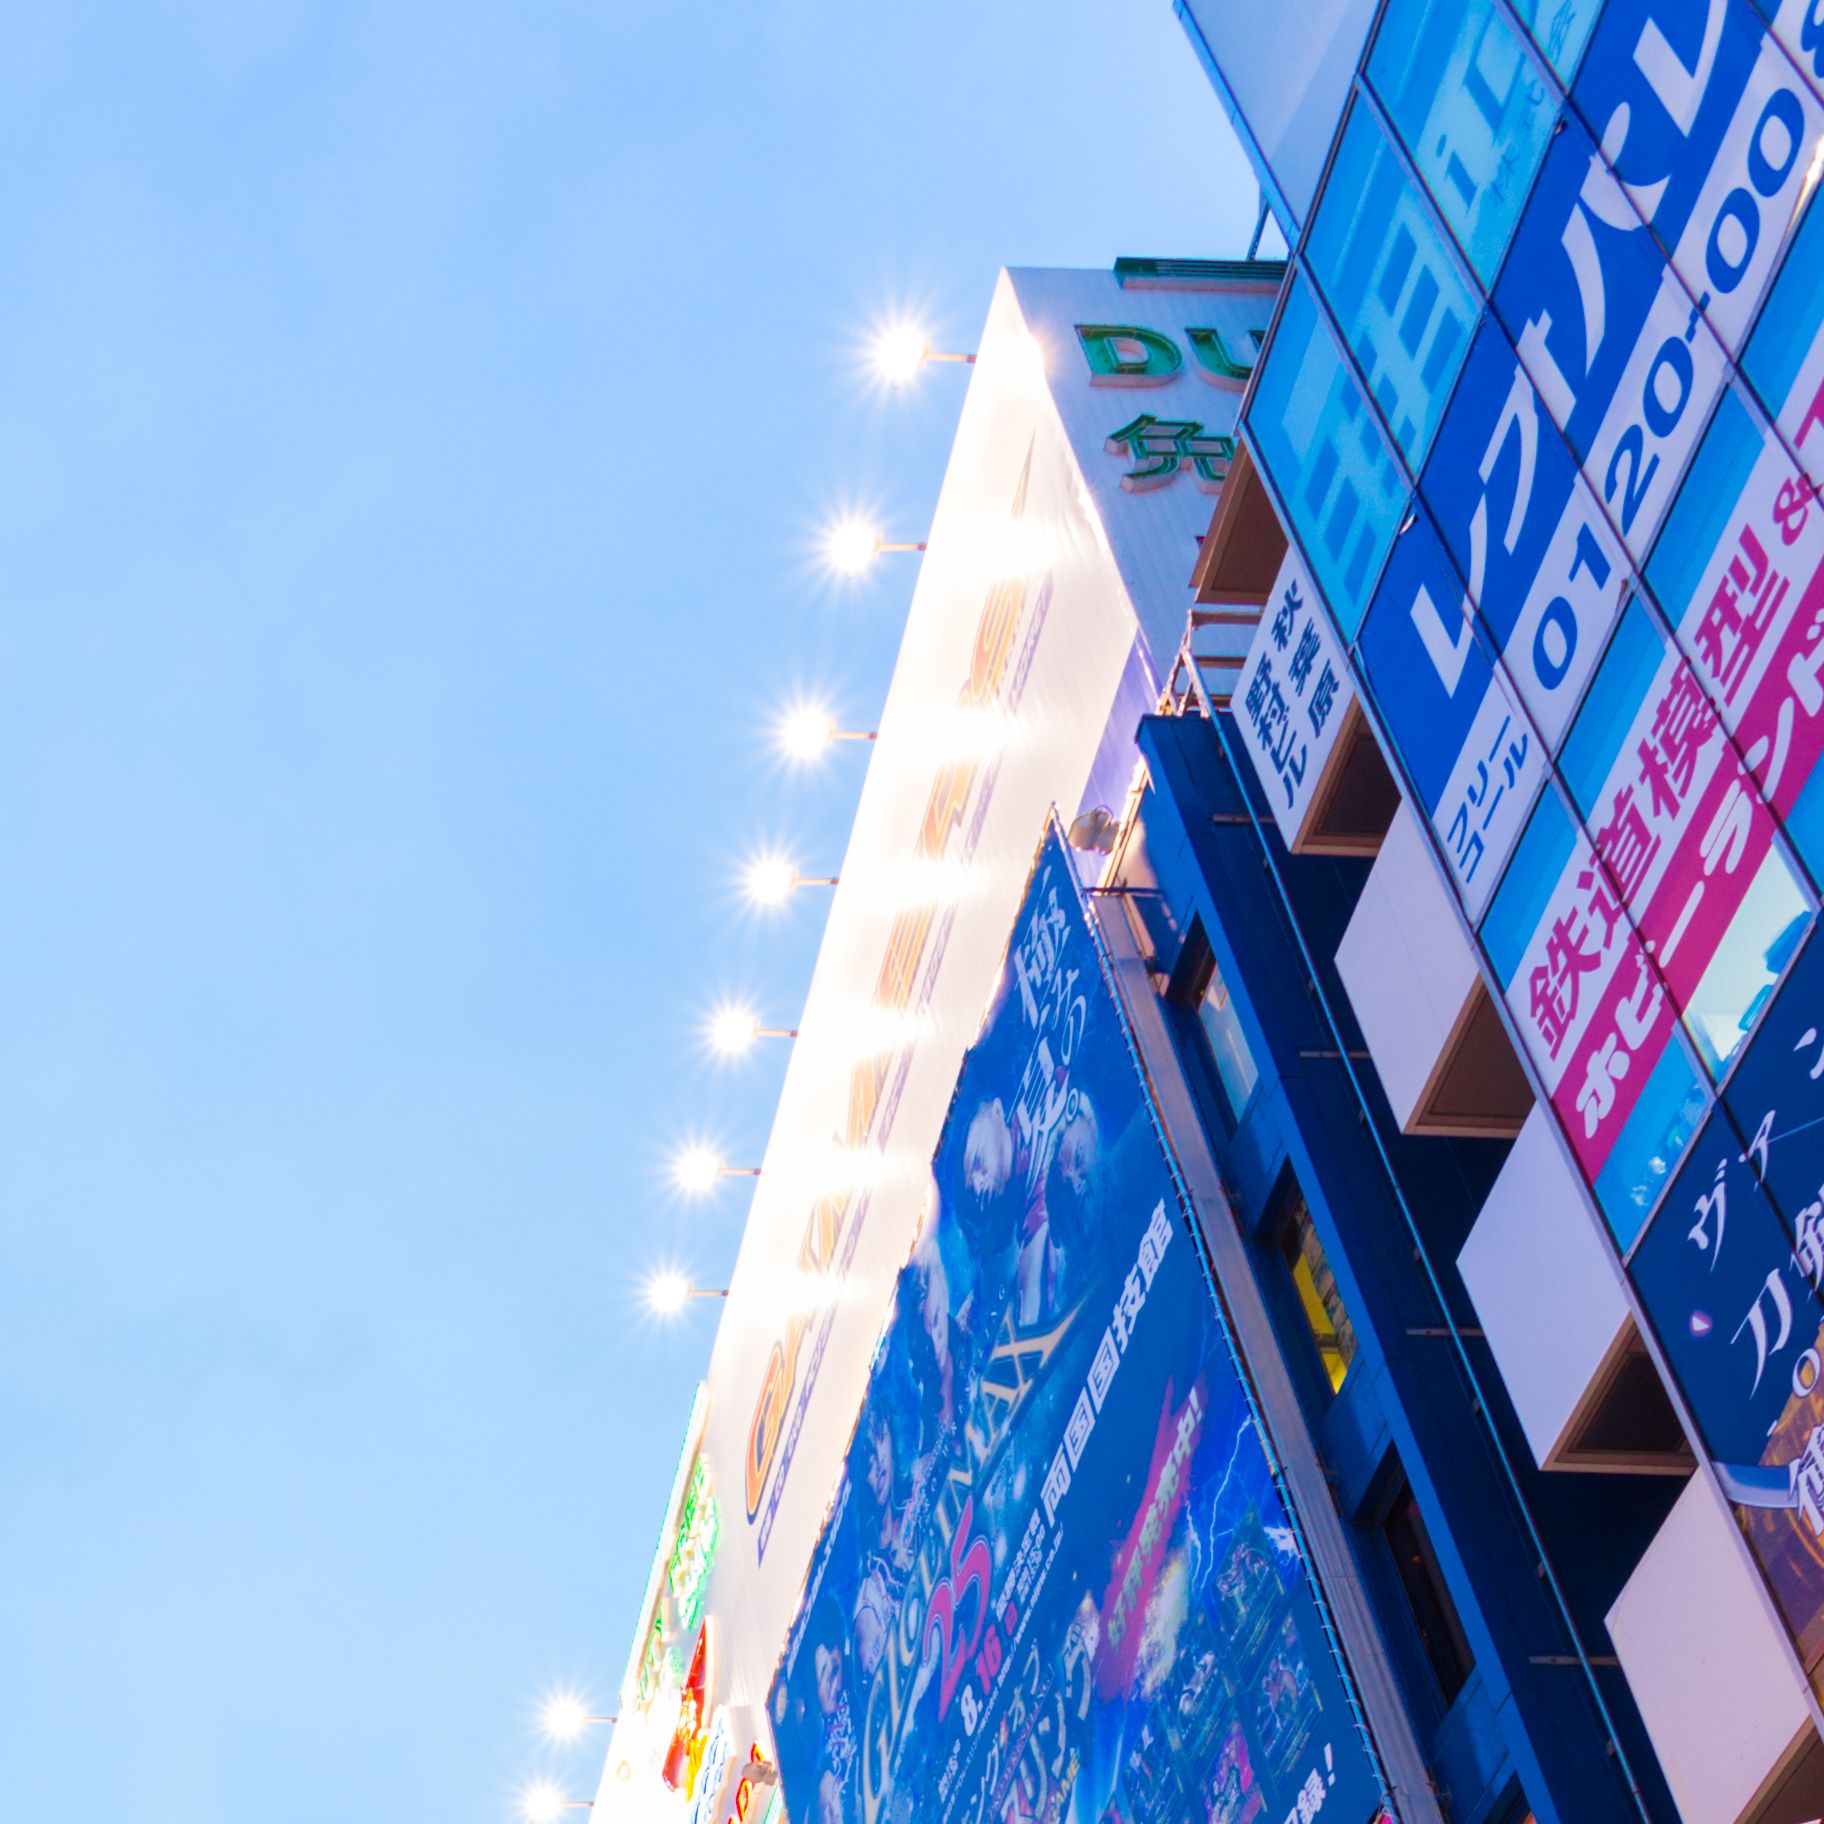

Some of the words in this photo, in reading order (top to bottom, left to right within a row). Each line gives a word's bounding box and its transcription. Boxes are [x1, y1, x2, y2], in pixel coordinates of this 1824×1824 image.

[1244, 650, 1308, 809] 野村ビル
[1270, 580, 1341, 738] 秋葉原
[1446, 714, 1511, 848] フリー
[1466, 734, 1528, 884] コール
[1530, 520, 1791, 1060] 鉄道模型
[1039, 1185, 1175, 1537] 両国国技館
[917, 1483, 1000, 1736] 25
[958, 1614, 1004, 1745] 8.16
